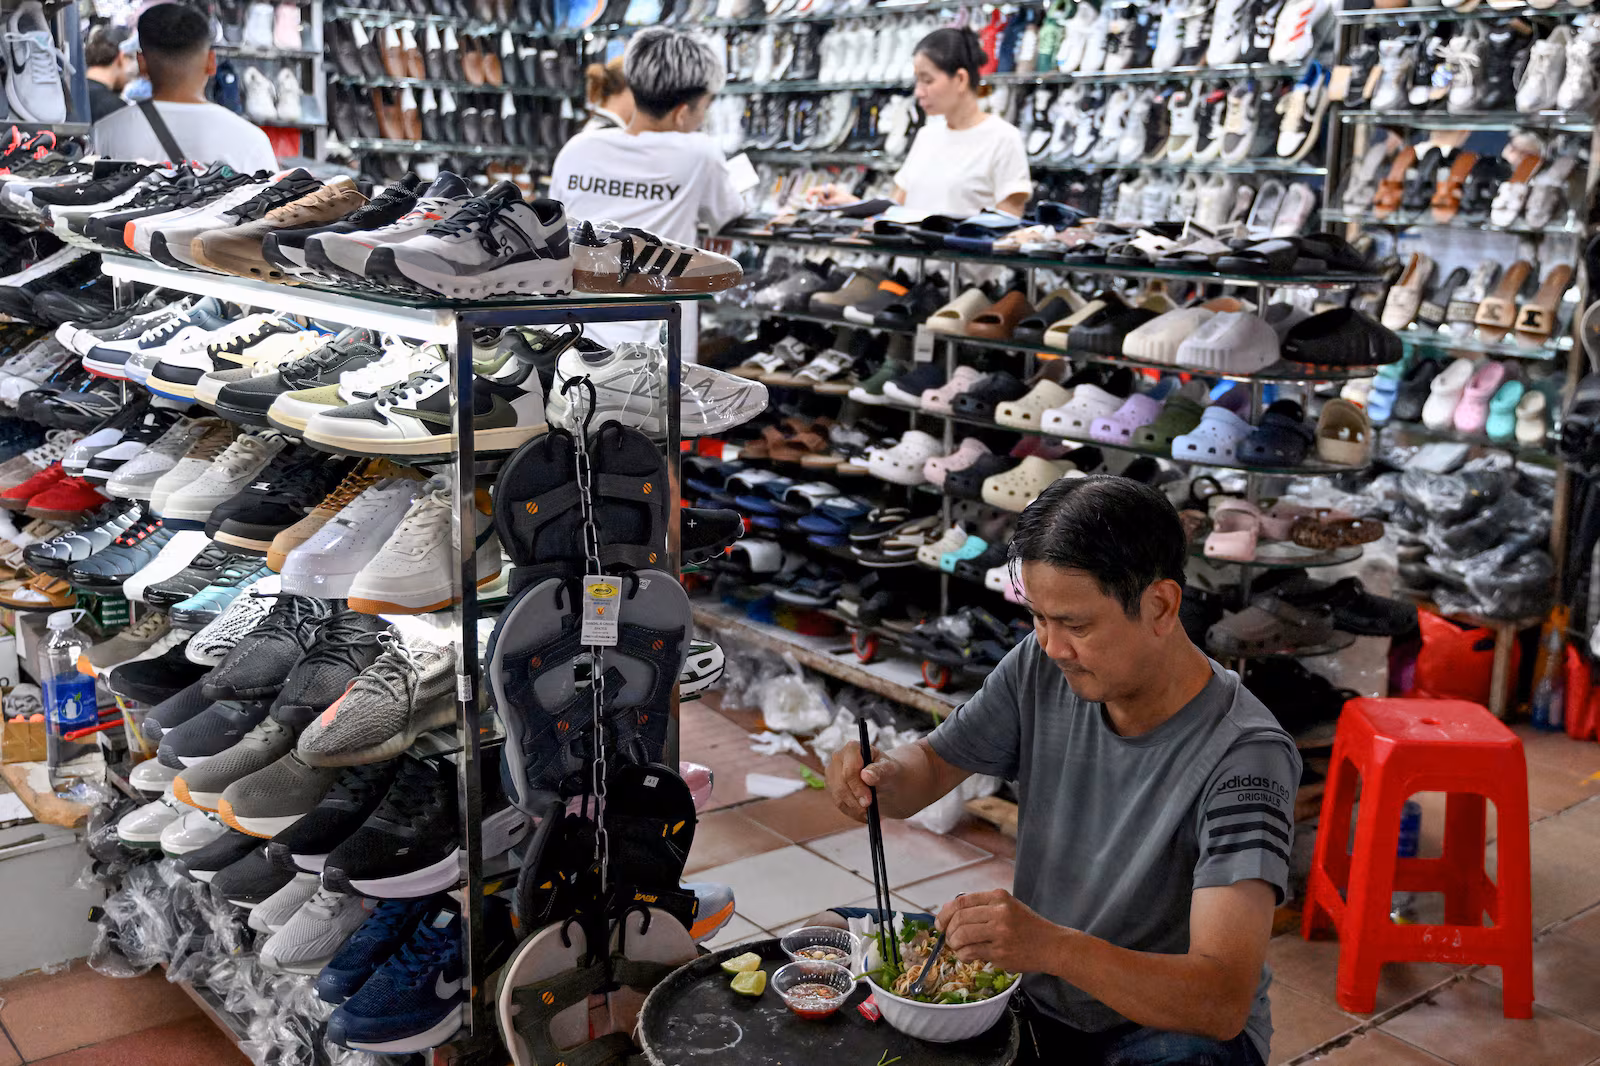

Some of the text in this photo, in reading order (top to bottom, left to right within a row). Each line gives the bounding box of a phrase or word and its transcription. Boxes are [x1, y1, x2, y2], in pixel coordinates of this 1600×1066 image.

[568, 174, 680, 200] BURBERRY
[1217, 774, 1290, 800] adidas neo
[1238, 793, 1281, 807] ORIGINALS
